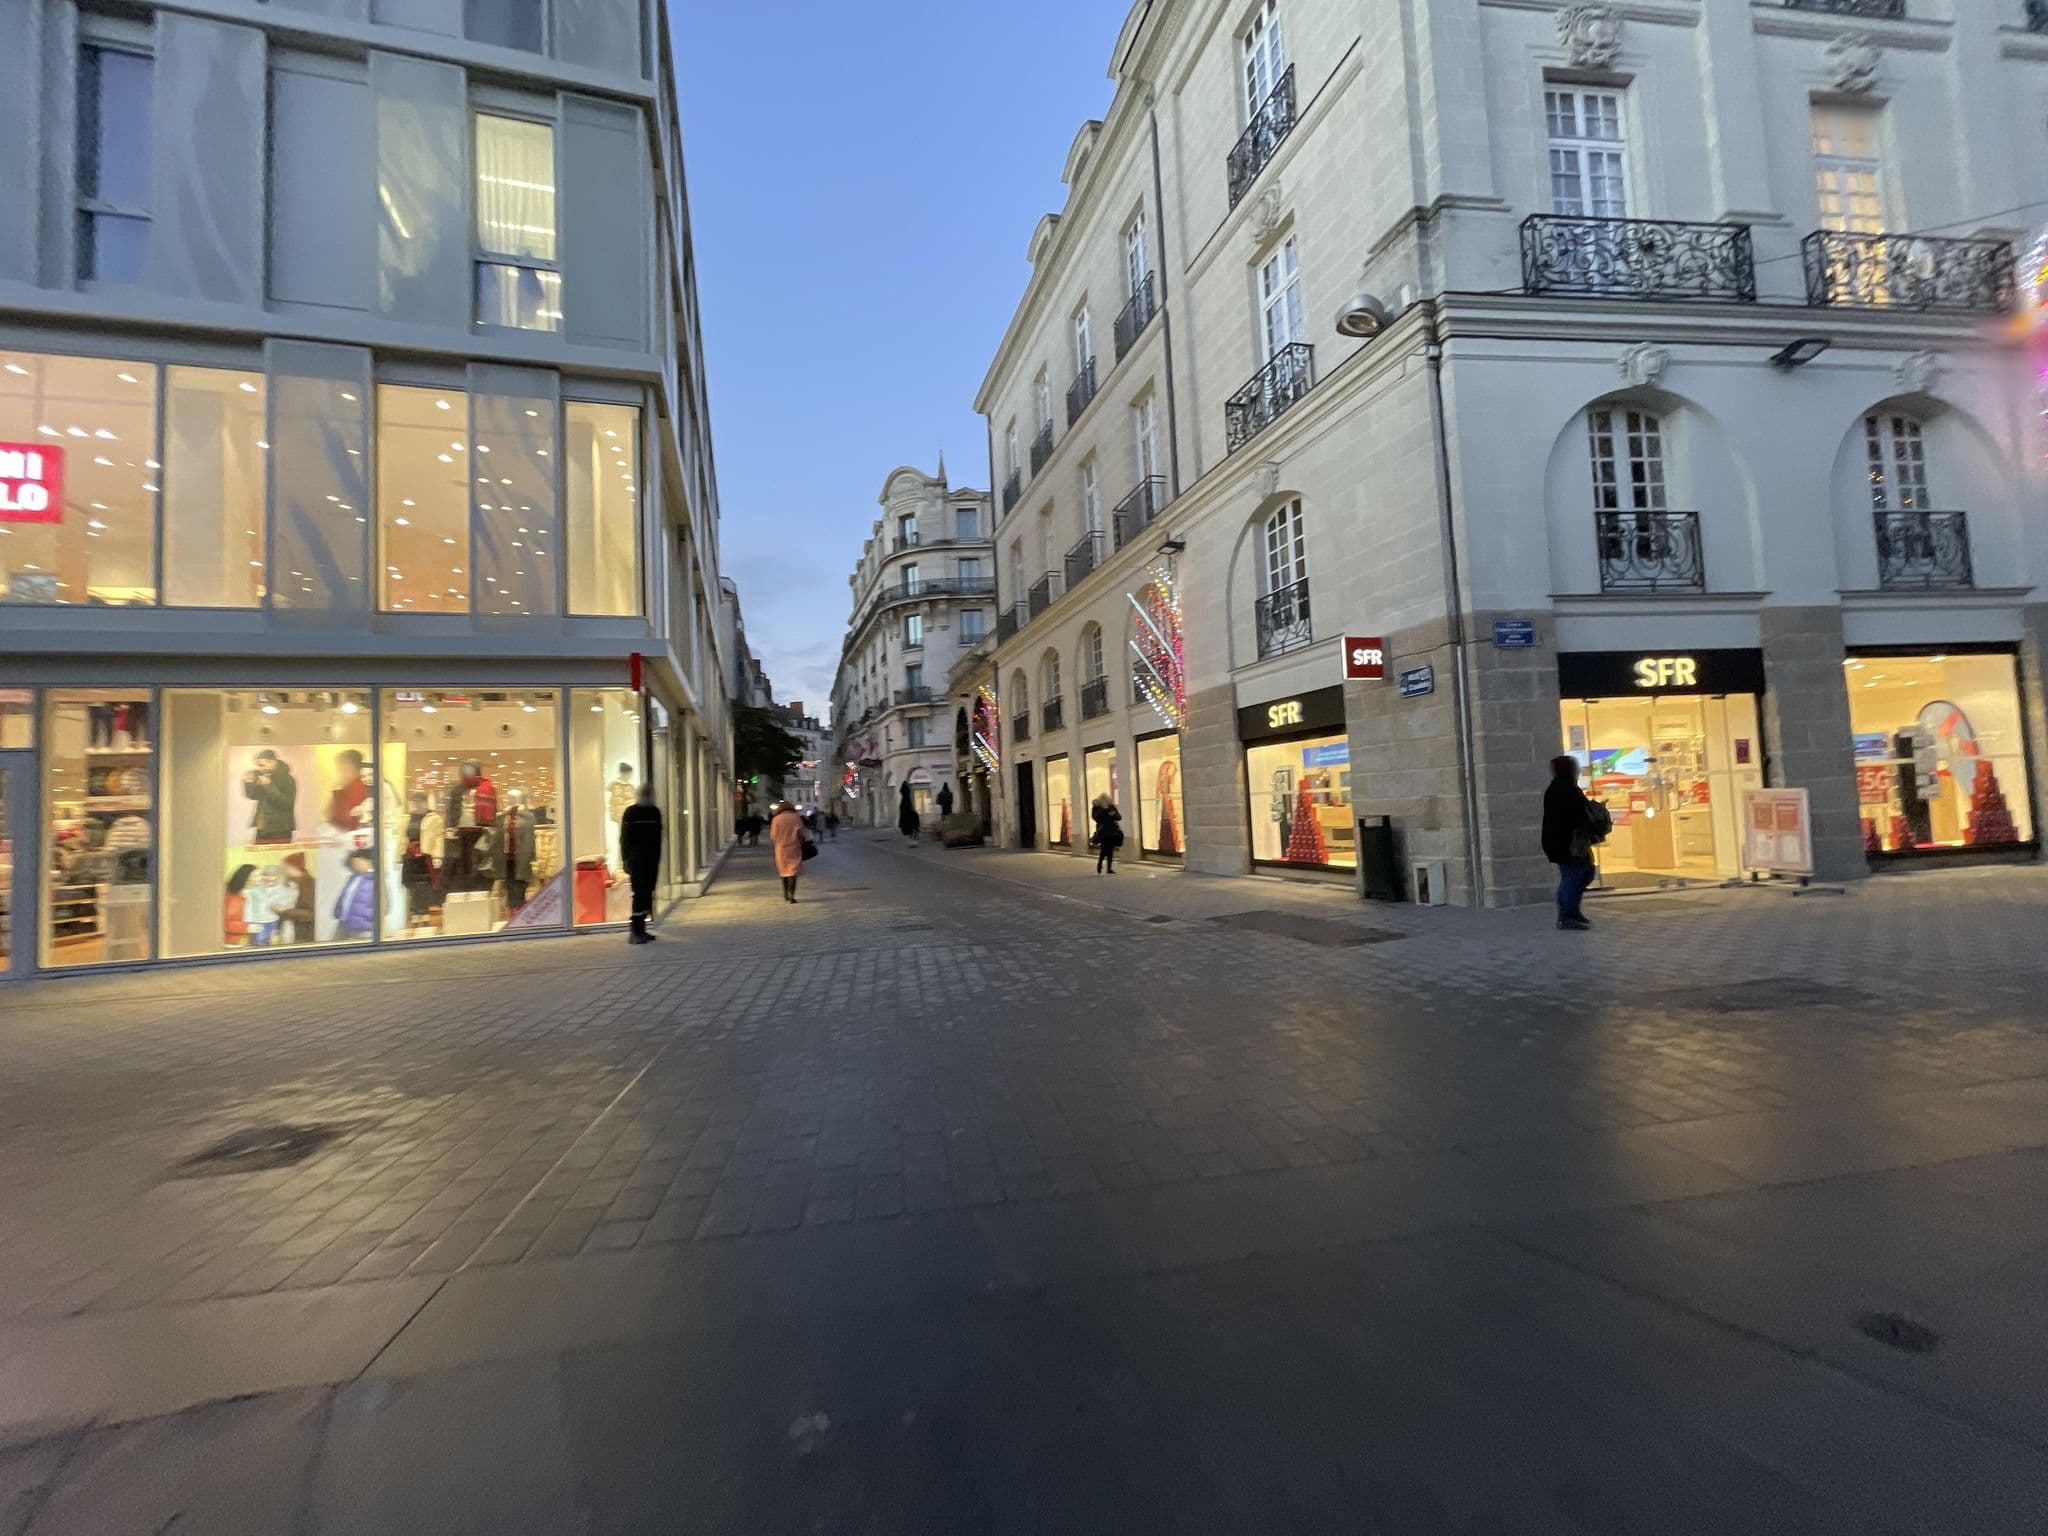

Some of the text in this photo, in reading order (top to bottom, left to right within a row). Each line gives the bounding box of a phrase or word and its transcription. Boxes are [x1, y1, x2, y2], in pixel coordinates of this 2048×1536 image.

[1353, 649, 1383, 665] SFR
[1634, 658, 1697, 687] SFR
[1268, 701, 1303, 728] SFR
